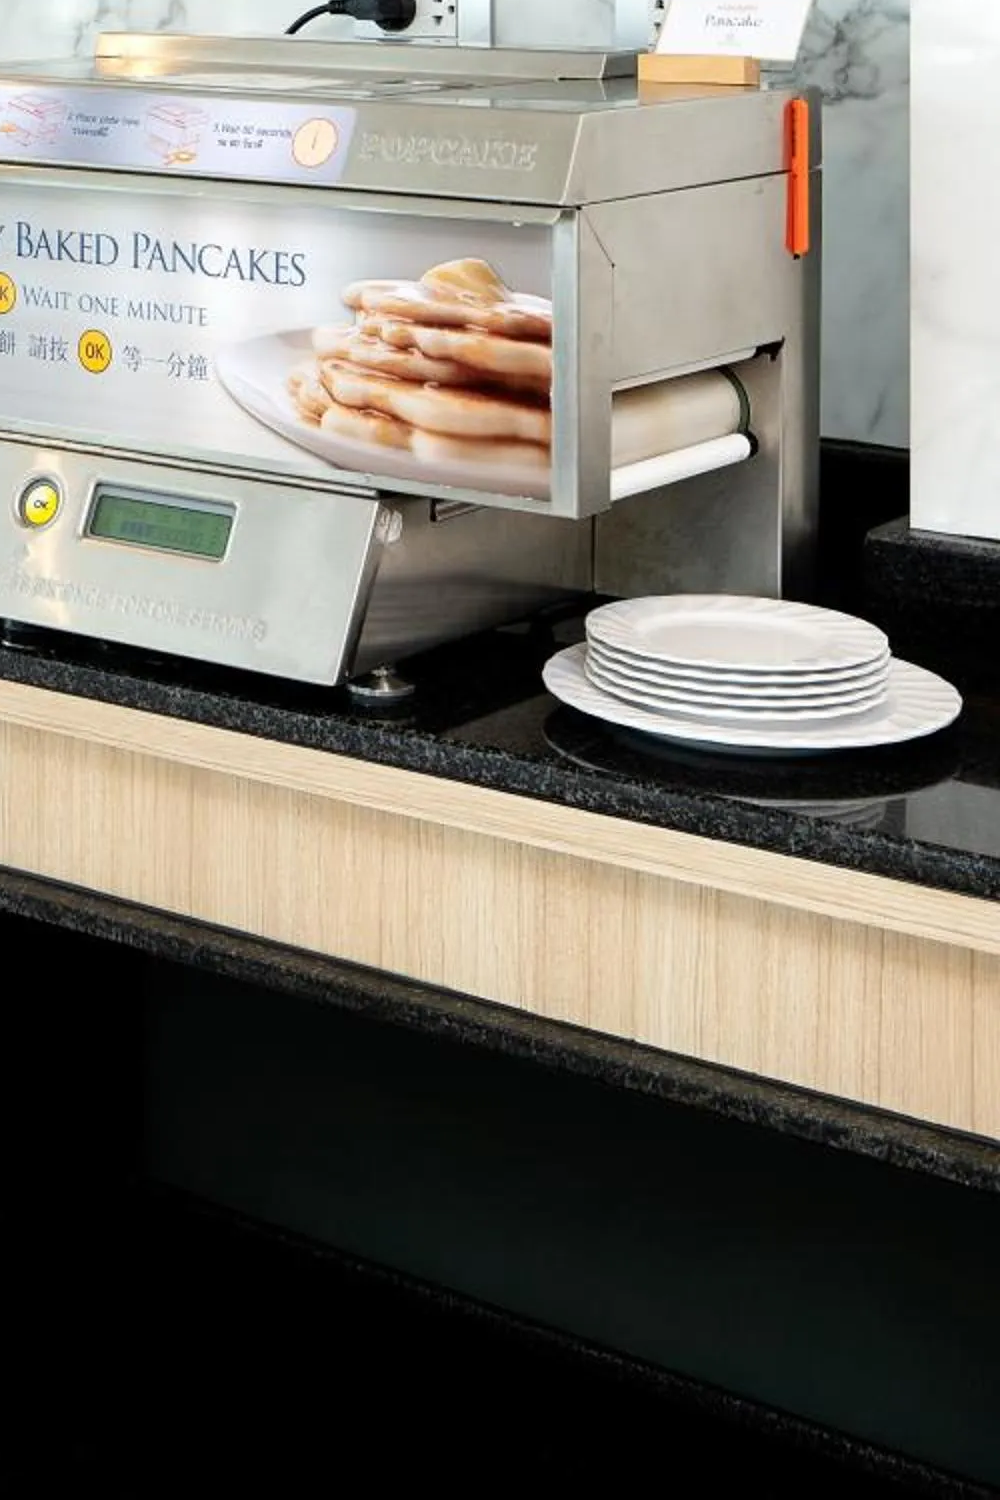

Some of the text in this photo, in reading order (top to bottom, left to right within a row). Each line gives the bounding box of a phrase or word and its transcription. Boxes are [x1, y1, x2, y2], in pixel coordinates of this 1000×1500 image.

[17, 221, 119, 266] BAKED
[132, 231, 307, 288] PANCAKES
[22, 284, 73, 311] WAIT
[78, 295, 120, 318] ONE
[127, 301, 208, 327] MINUTE
[29, 334, 69, 361] 請按
[85, 341, 105, 360] OK
[122, 344, 209, 380] 等一分鐘
[33, 499, 49, 511] OK
